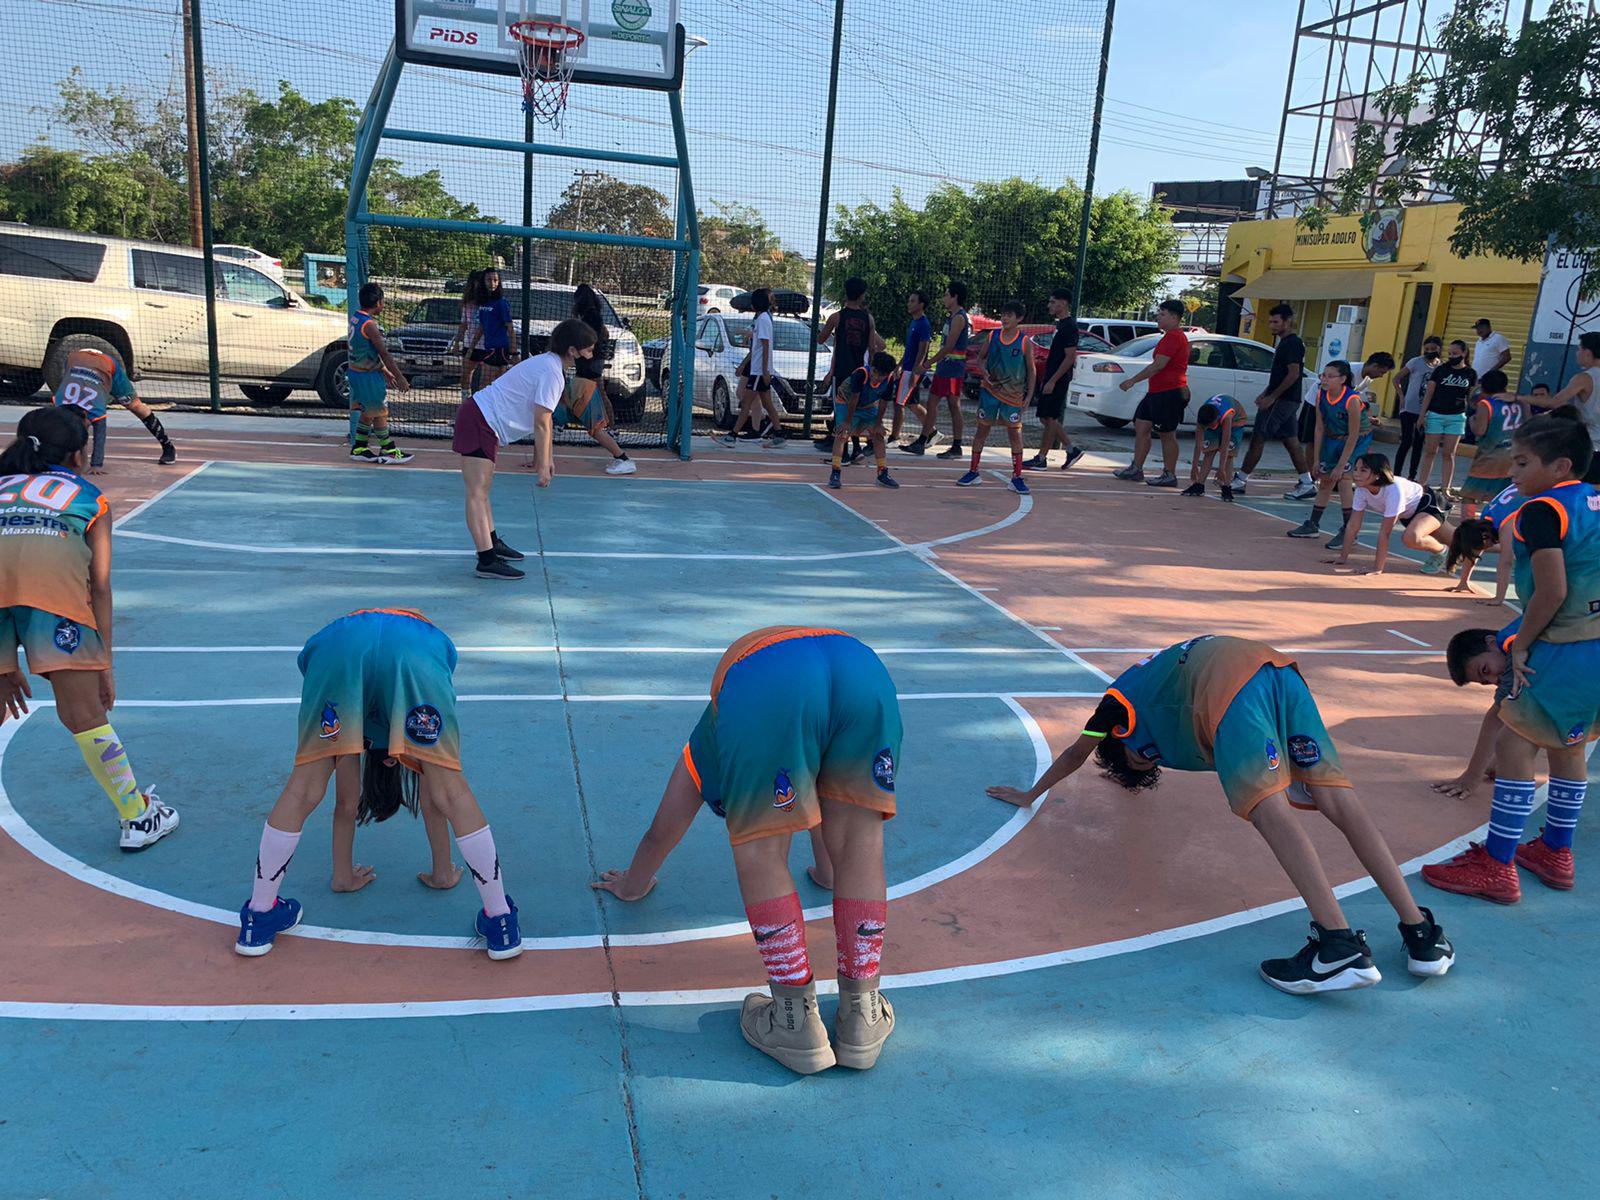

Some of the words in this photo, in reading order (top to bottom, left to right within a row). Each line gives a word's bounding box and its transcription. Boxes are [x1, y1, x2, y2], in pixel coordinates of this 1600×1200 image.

[1296, 232, 1329, 246] MINISUPER
[1331, 231, 1357, 245] ADOLFO
[1556, 252, 1569, 269] EL
[1501, 403, 1522, 431] 22
[1, 527, 59, 537] Mazatlán
